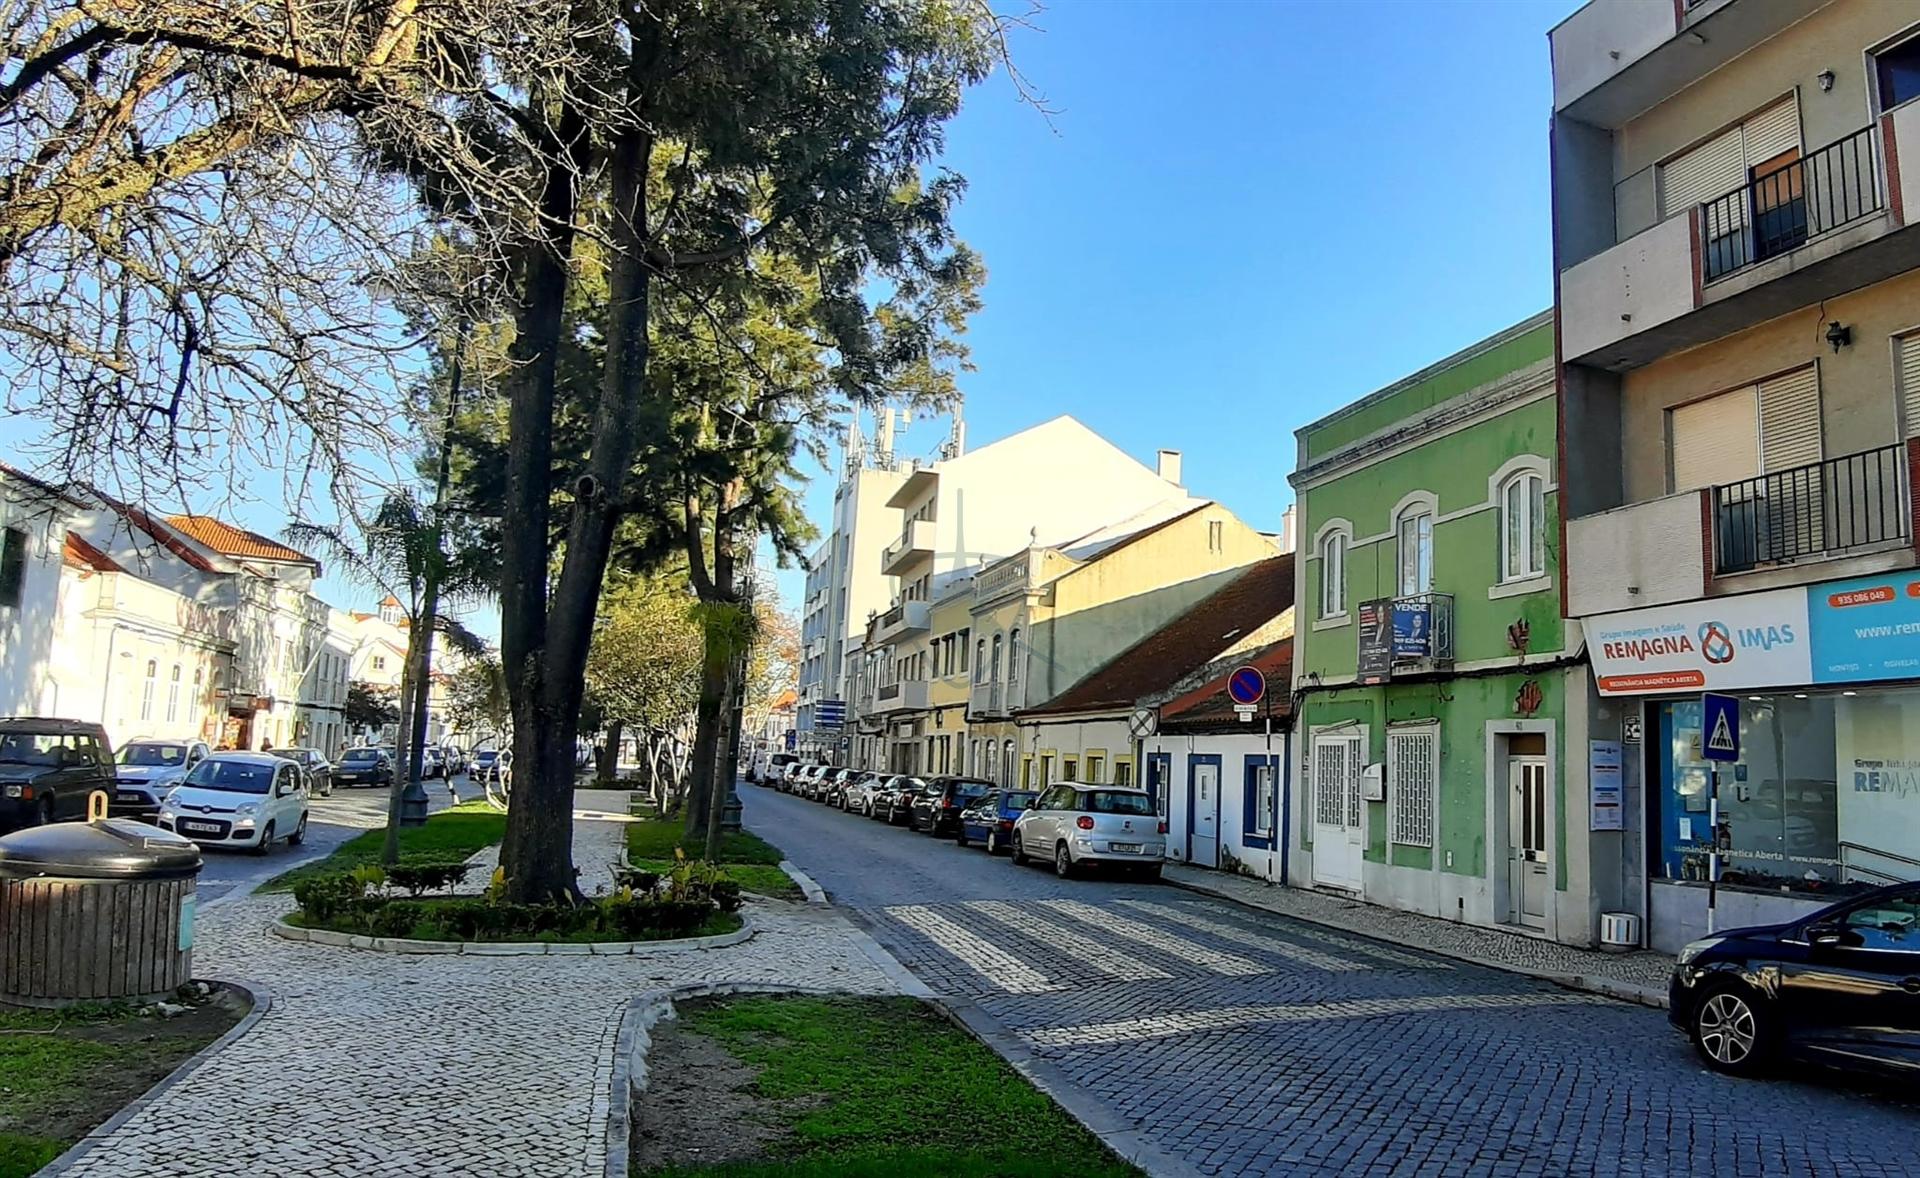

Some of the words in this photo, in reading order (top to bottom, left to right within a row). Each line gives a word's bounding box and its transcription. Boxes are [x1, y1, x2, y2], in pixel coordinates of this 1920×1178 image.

[1395, 603, 1428, 612] VENDE
[1838, 596, 1853, 605] 935
[1870, 590, 1885, 600] 049
[1738, 624, 1795, 650] IMAS
[1603, 635, 1694, 661] REMAGNA
